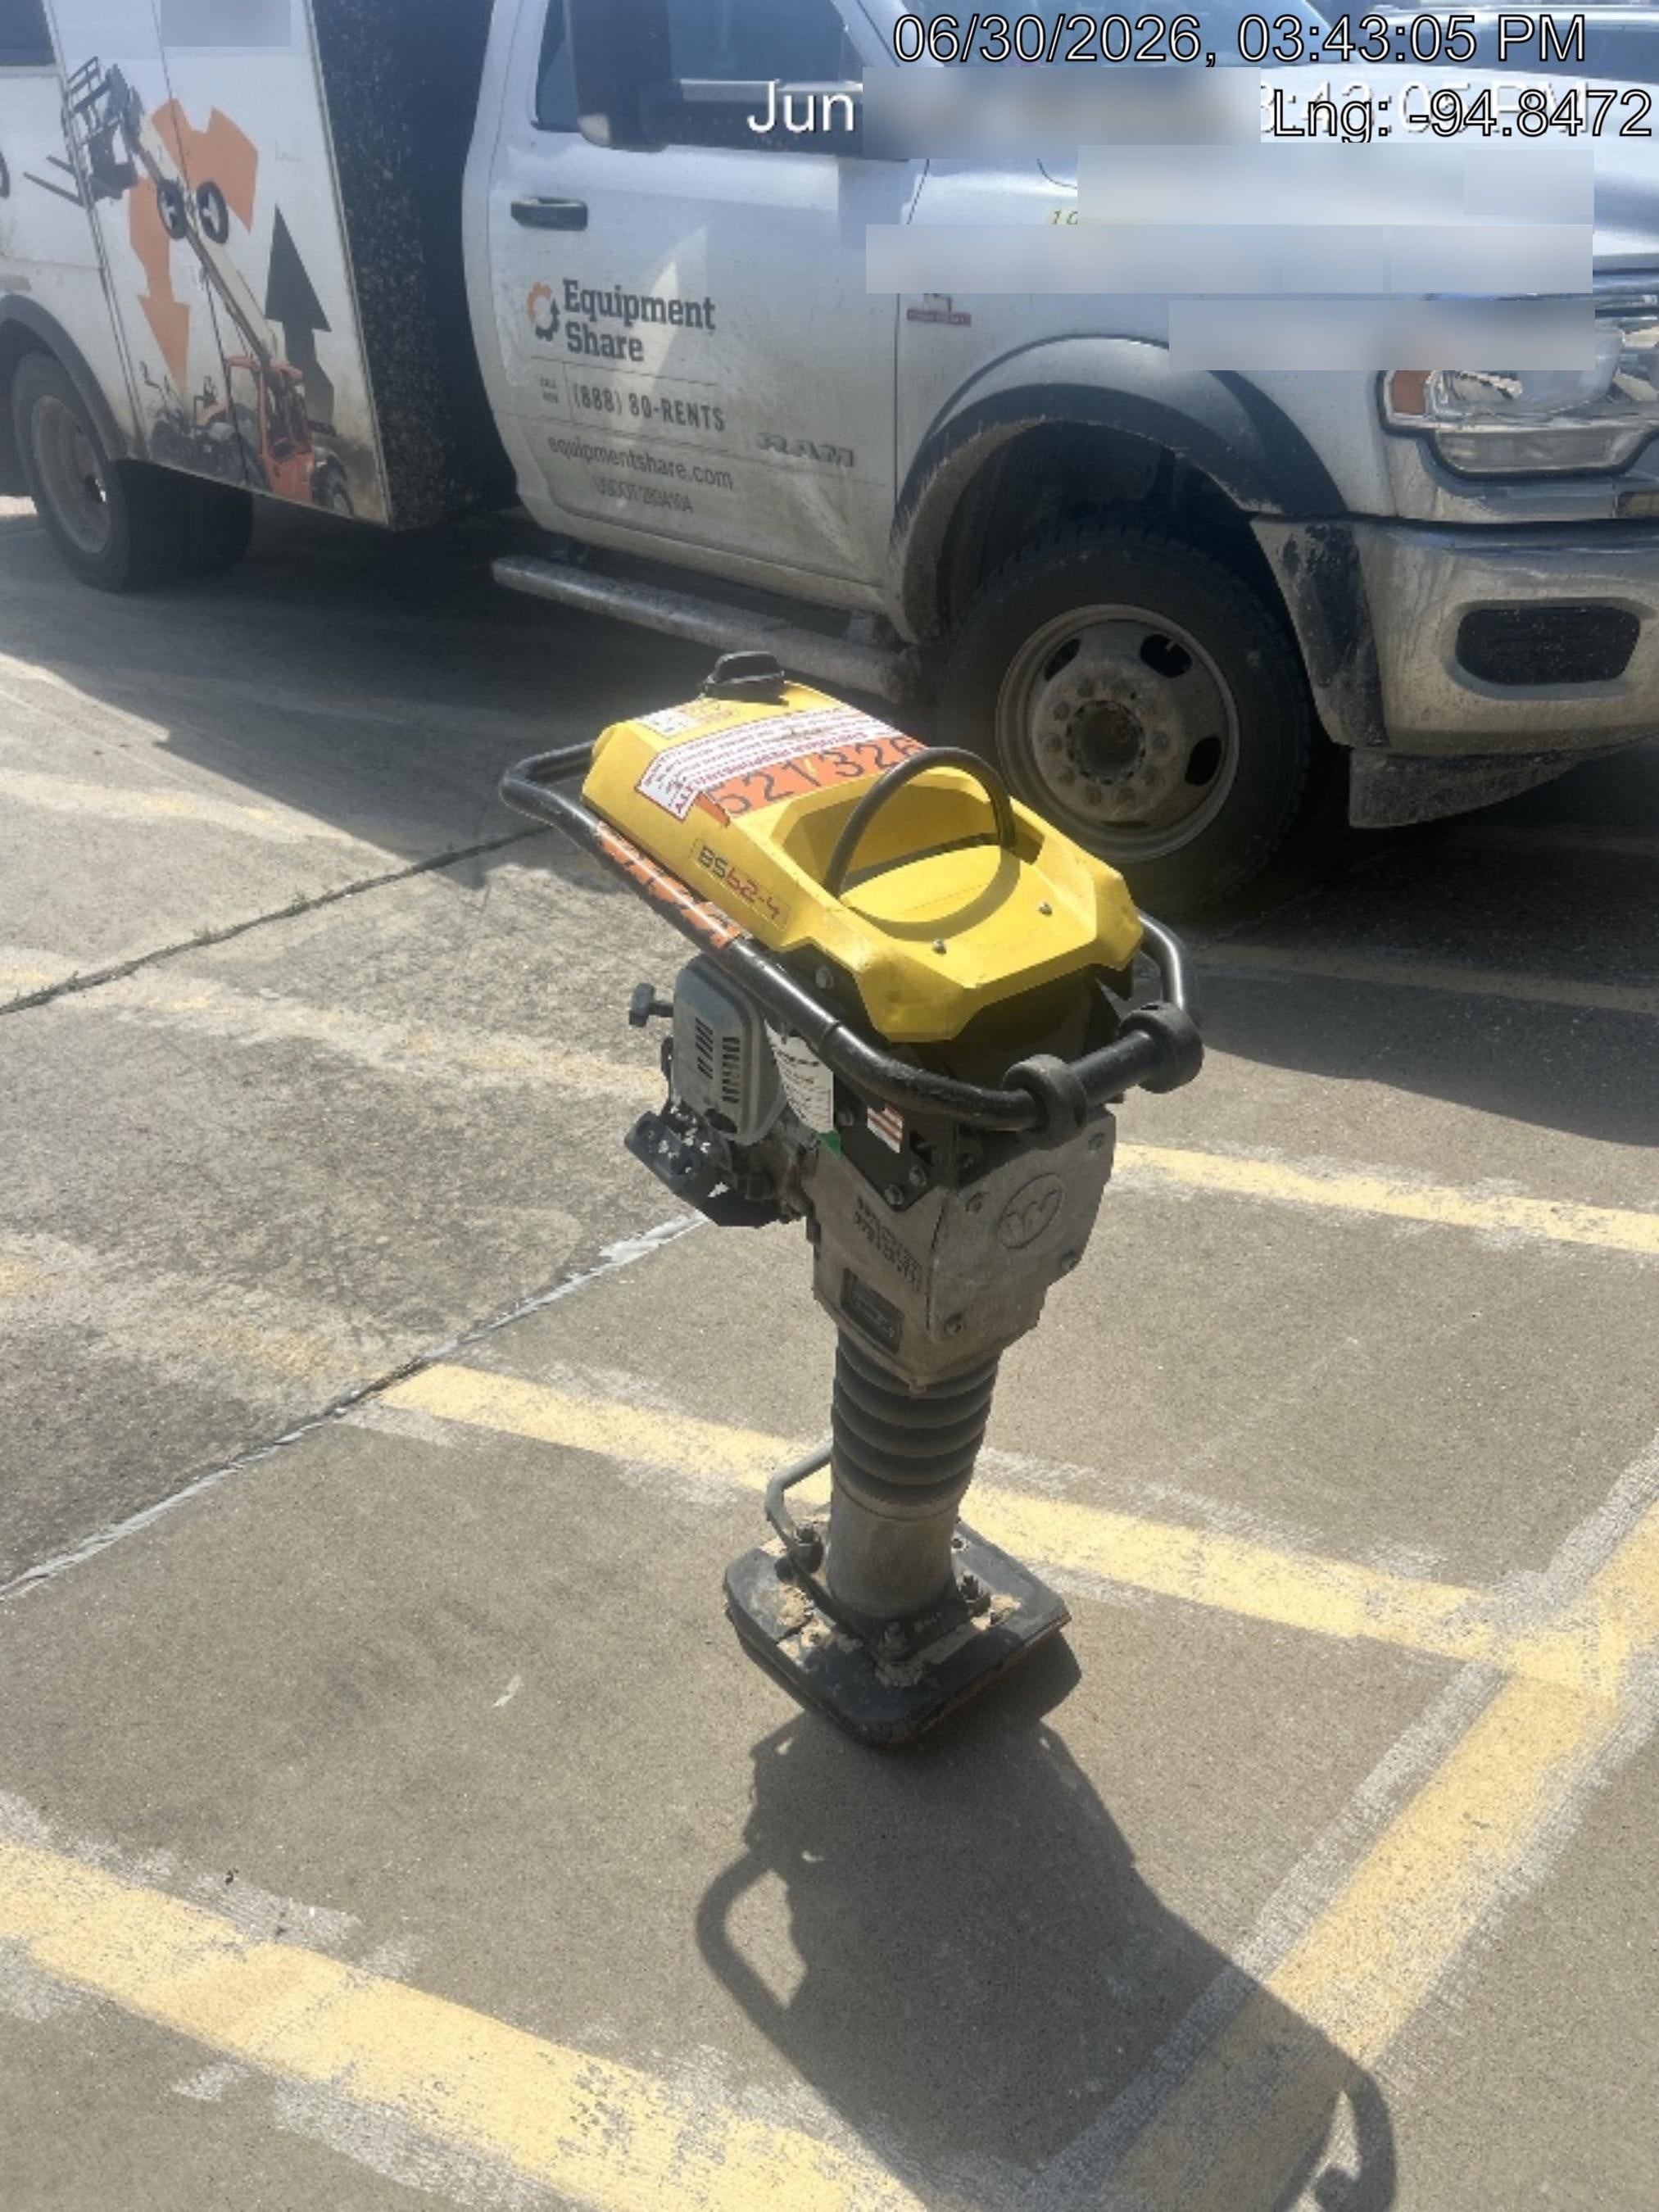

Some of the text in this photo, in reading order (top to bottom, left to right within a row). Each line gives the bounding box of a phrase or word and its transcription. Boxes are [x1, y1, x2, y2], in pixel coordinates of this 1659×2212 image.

[563, 277, 716, 331] Equipment
[565, 320, 645, 362] Share
[573, 383, 726, 432] (888) 80-RENTS
[547, 436, 733, 490] equipmentshare.com
